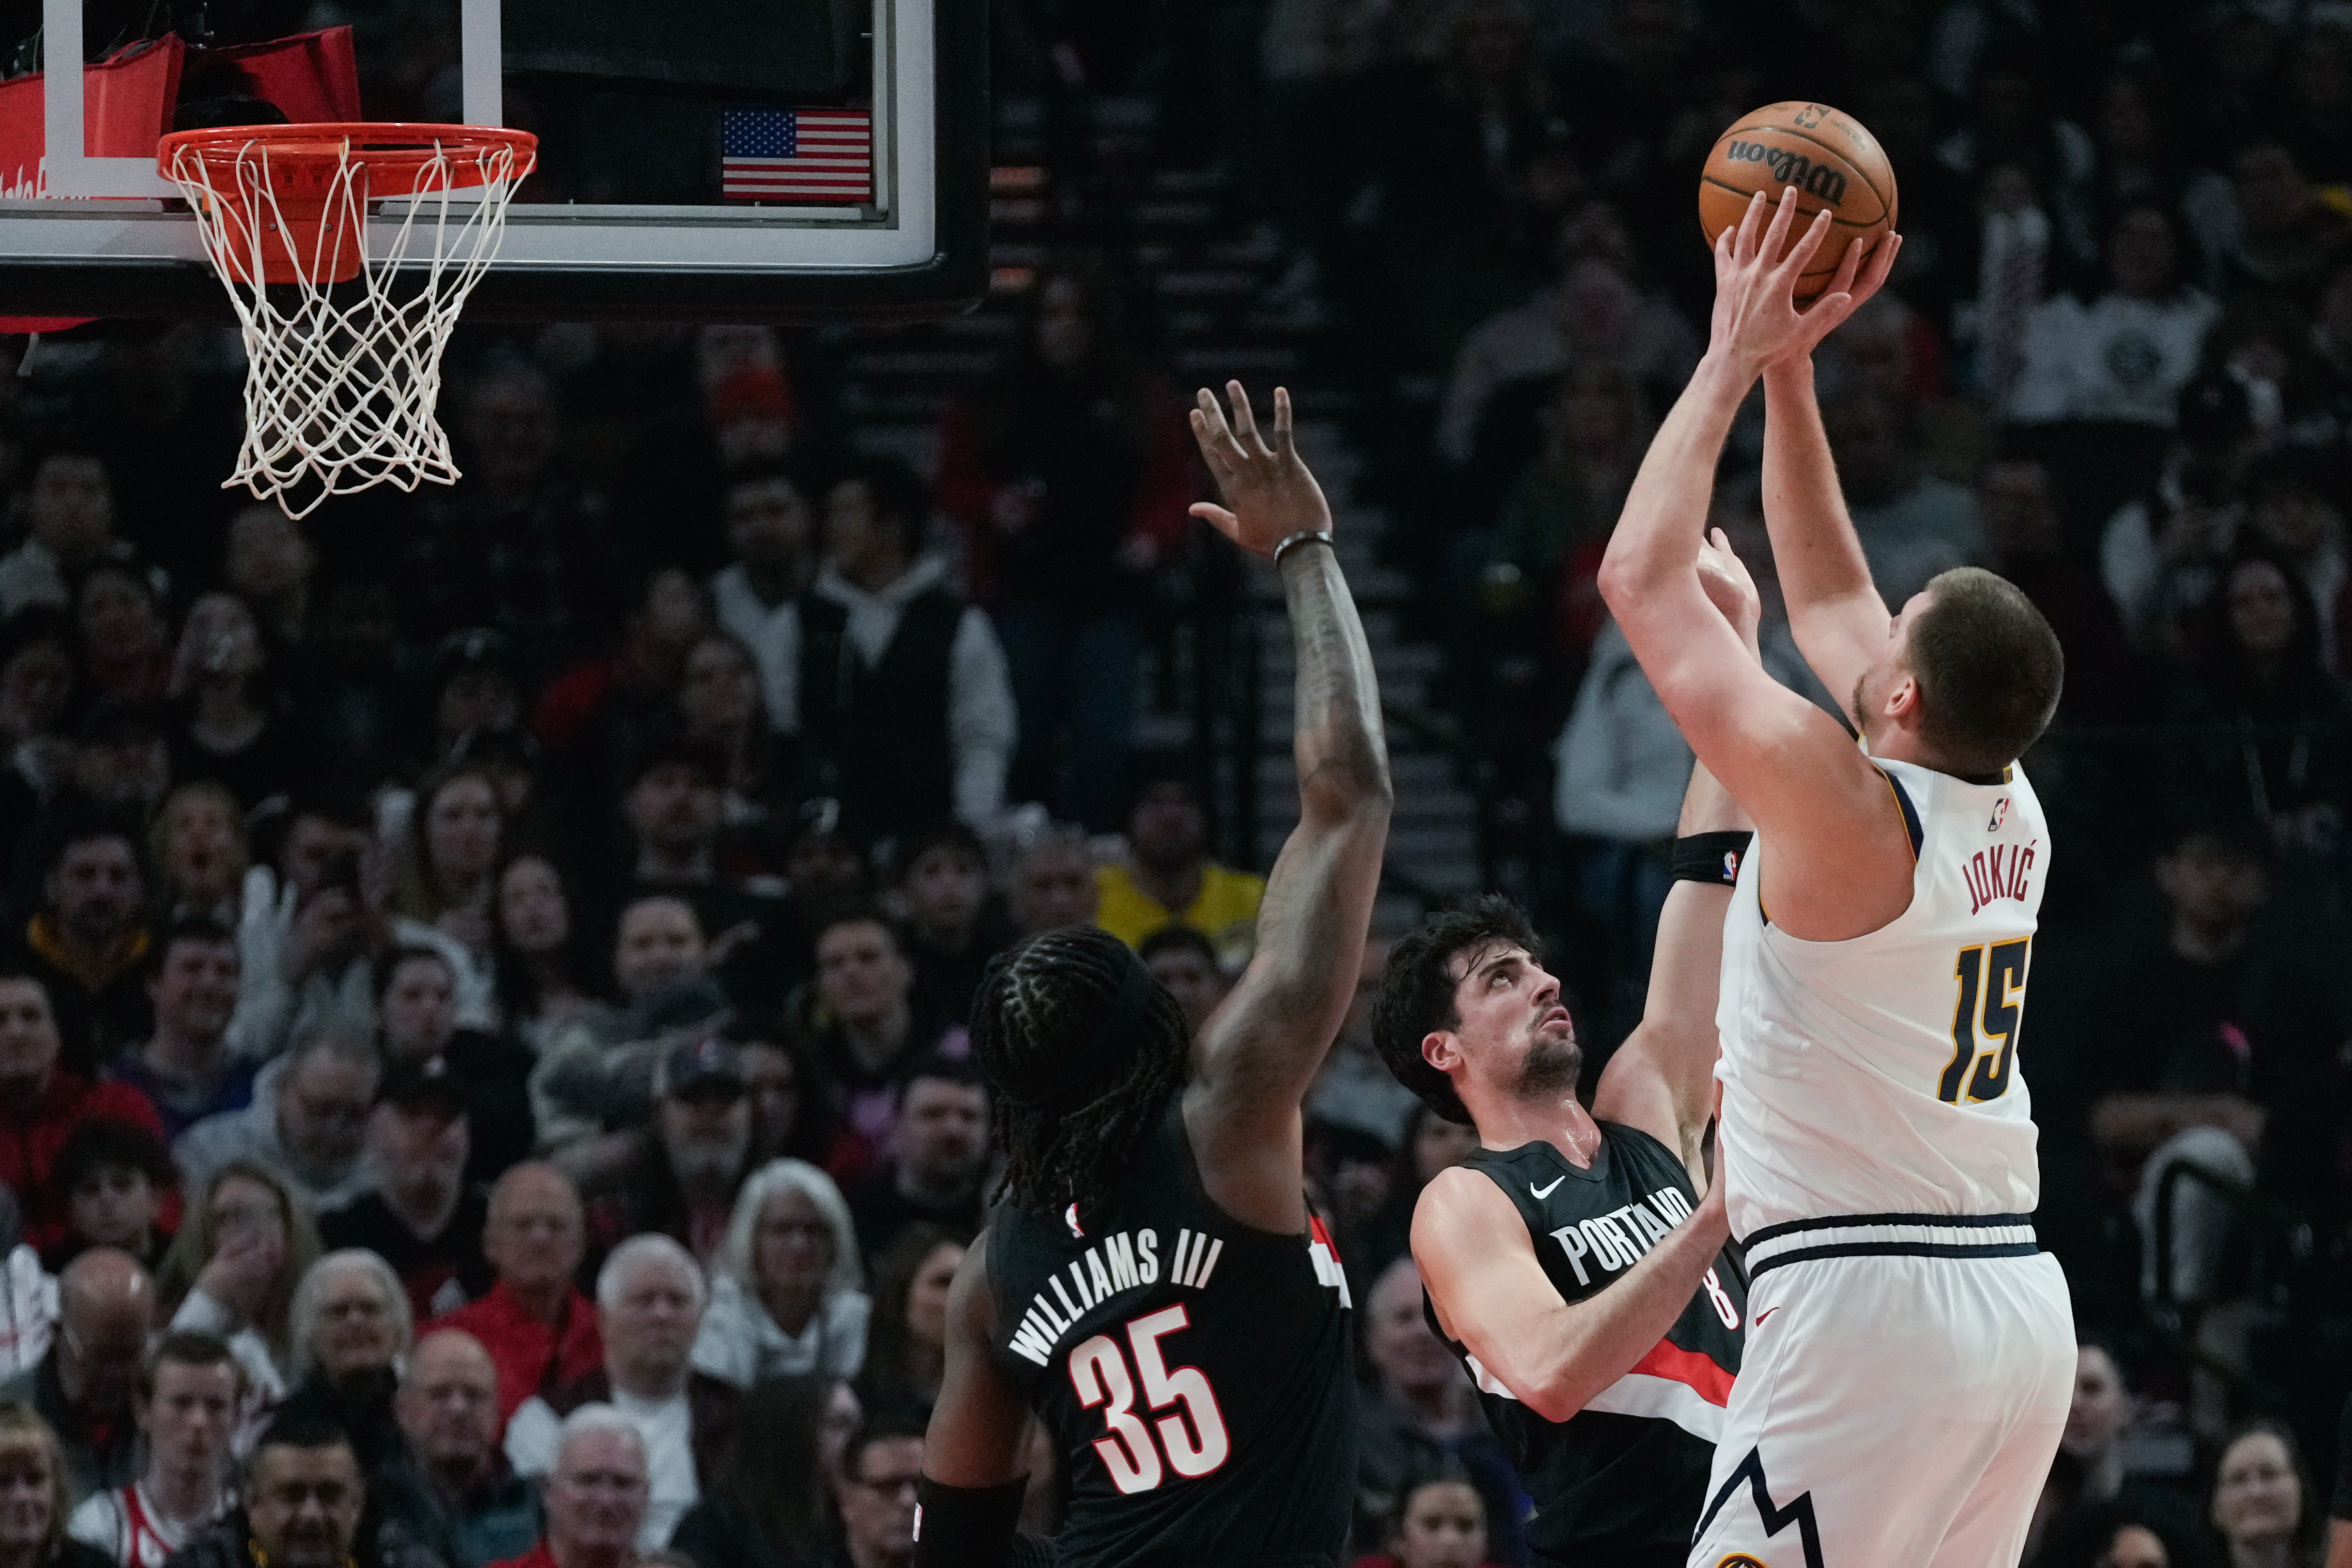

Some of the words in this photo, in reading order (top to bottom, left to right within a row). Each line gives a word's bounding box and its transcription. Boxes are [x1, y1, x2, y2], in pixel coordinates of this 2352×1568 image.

[1727, 140, 1847, 207] Wilson
[1962, 839, 2037, 915] JOKIĆ
[1937, 936, 2030, 1106] 15
[1549, 1186, 1694, 1286] PORTAND
[1008, 1228, 1159, 1367] WILLIAMS
[1171, 1229, 1223, 1289] III
[1069, 1303, 1230, 1494] 35
